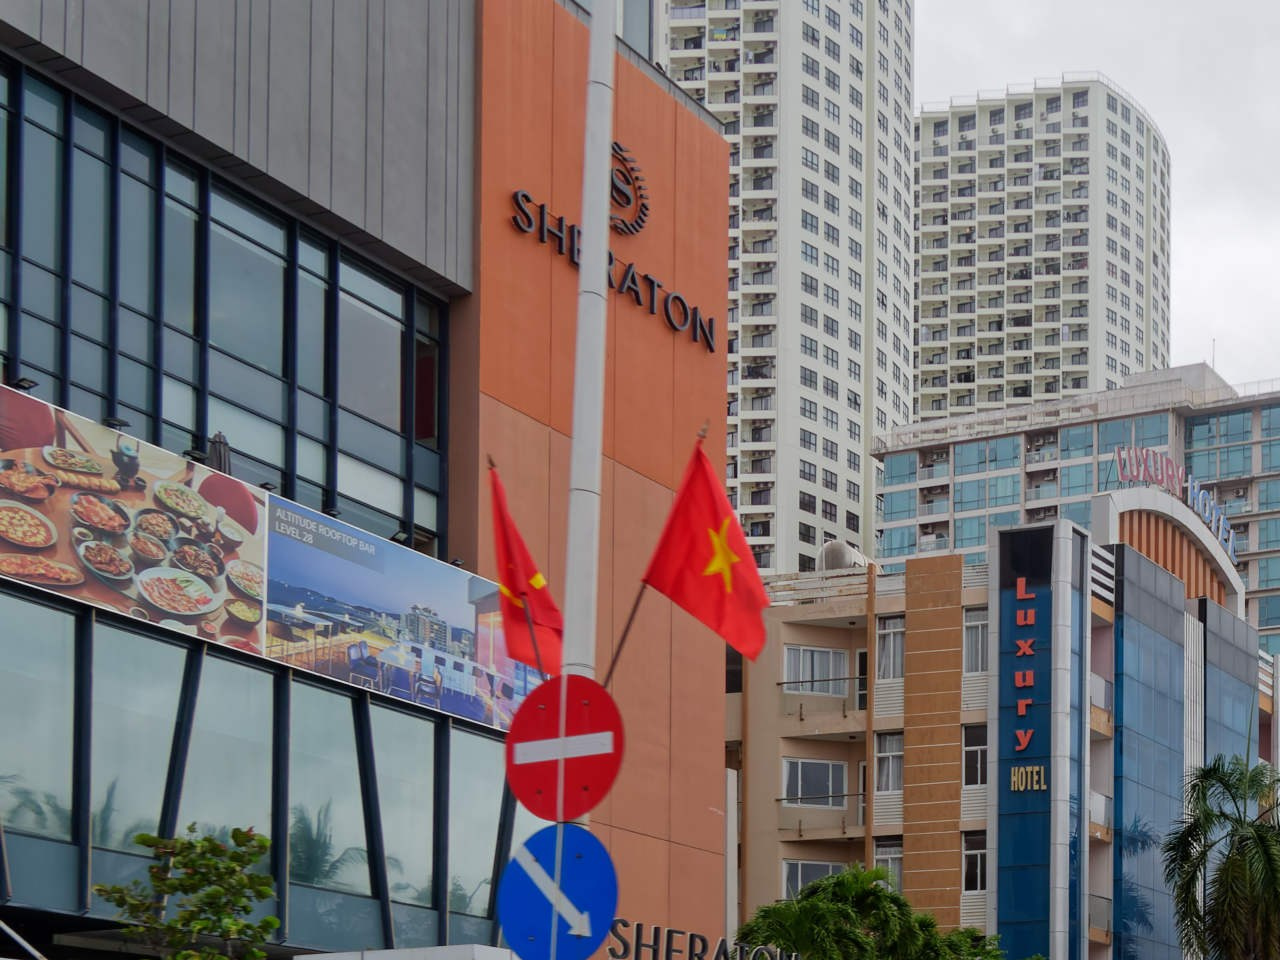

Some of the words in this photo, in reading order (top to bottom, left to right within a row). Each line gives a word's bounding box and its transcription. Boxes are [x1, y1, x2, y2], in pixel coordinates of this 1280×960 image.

[1116, 447, 1185, 498] LUXURY
[275, 508, 318, 533] ALTITUDE
[318, 523, 358, 548] ROOFTOP
[359, 540, 376, 556] BAR
[275, 521, 301, 541] LEVEL
[303, 532, 314, 544] 28
[1188, 474, 1239, 566] HOTEL
[1014, 576, 1036, 751] Luxury
[1010, 765, 1048, 792] HOTEL
